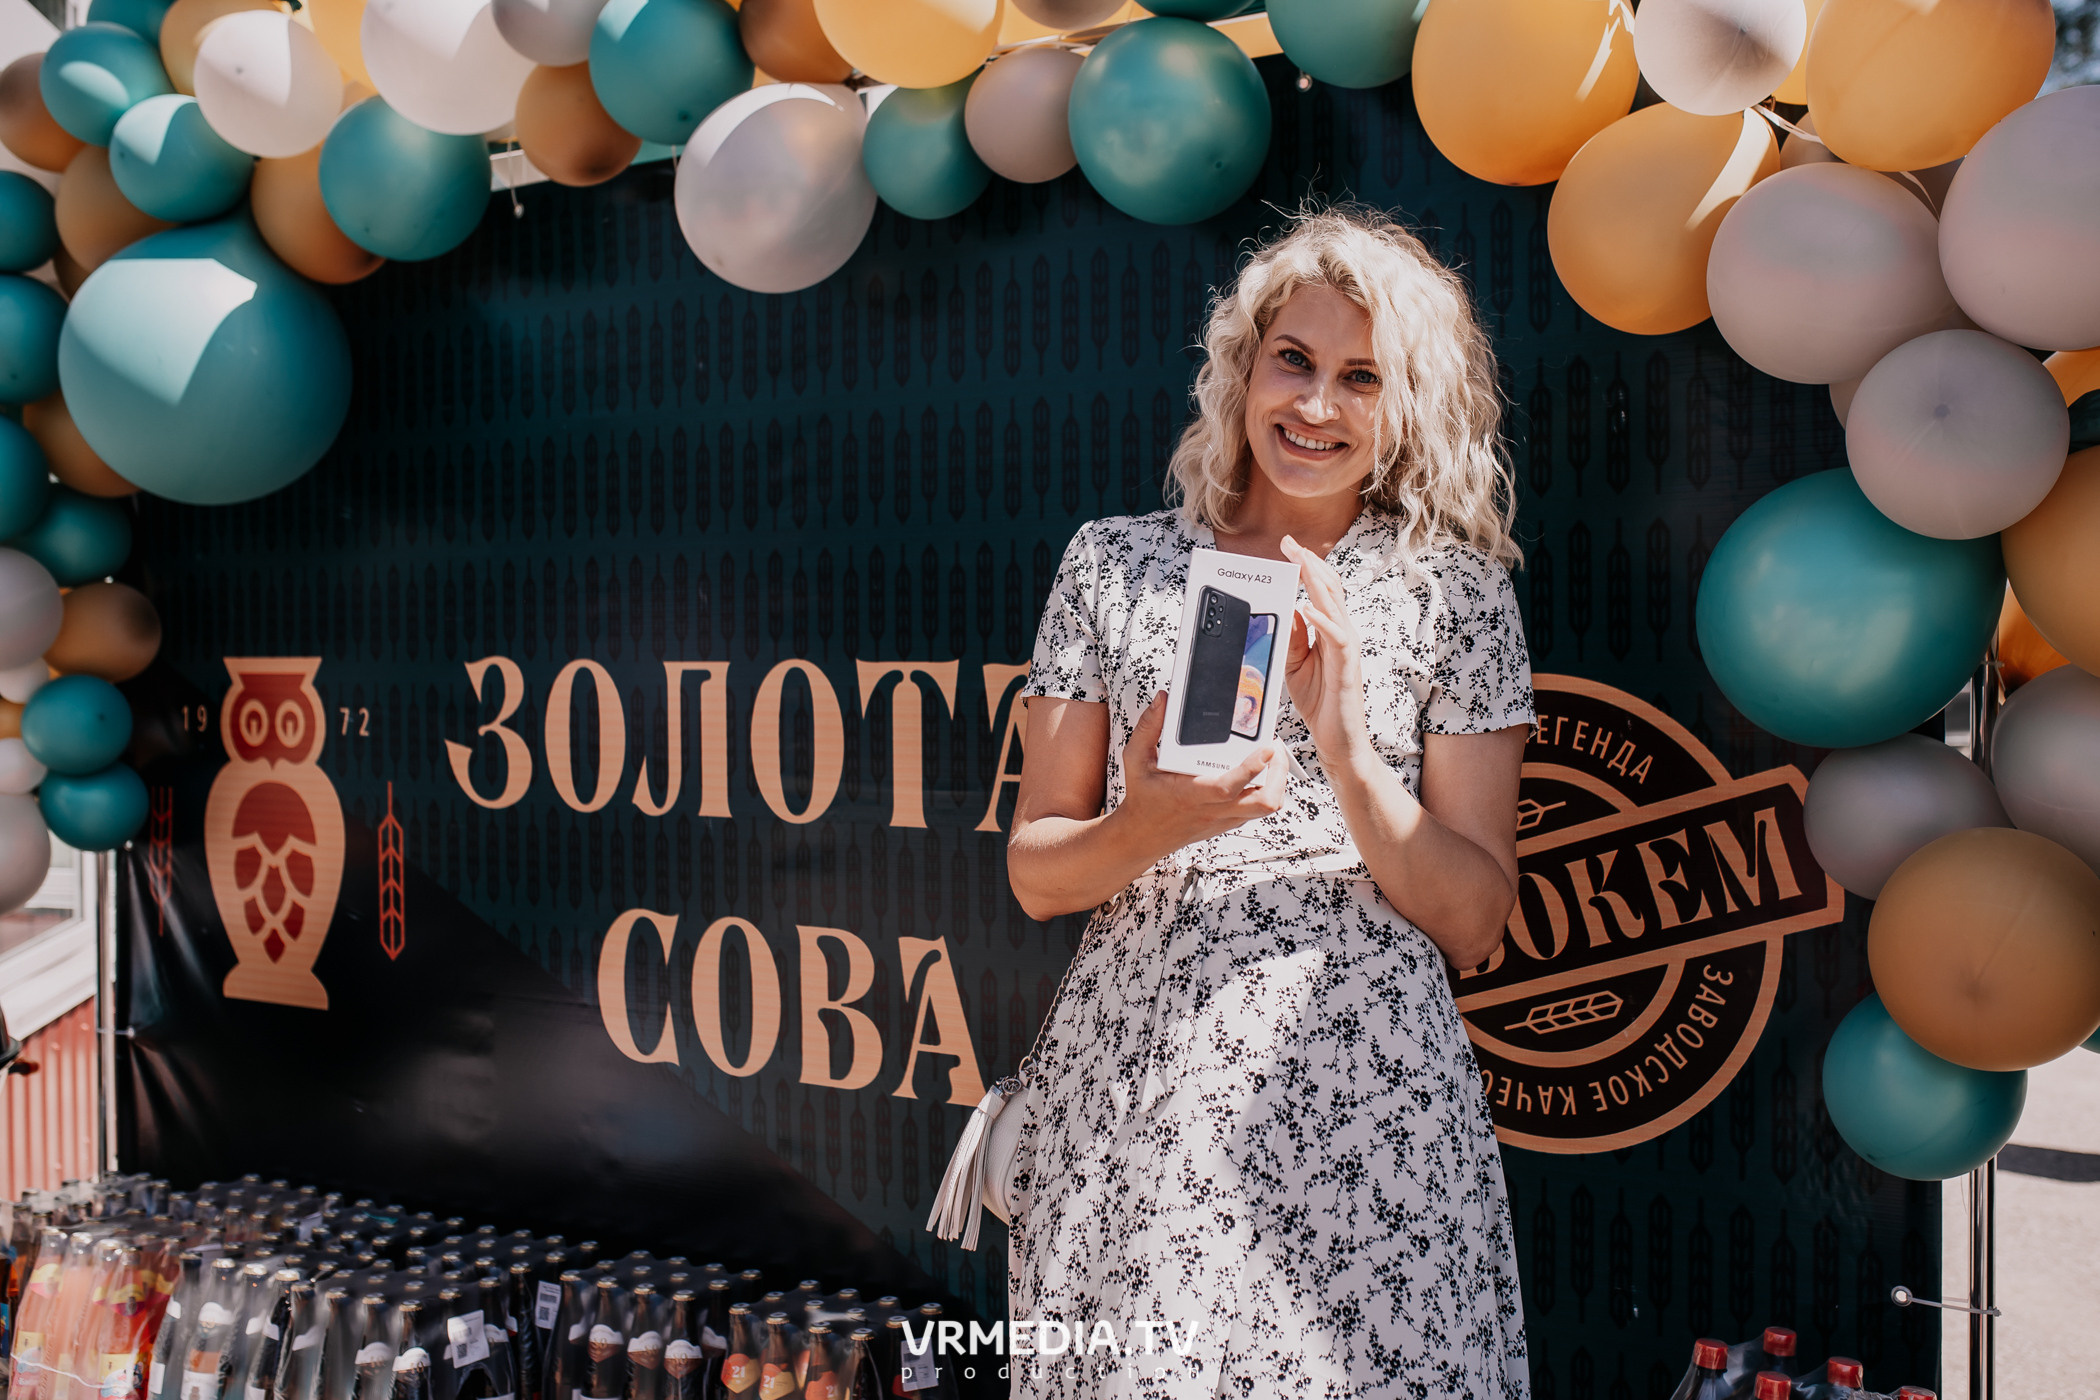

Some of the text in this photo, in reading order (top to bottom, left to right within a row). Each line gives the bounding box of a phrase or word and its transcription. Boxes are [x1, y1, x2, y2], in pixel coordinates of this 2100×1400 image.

[1217, 568, 1272, 584] Galaxy A23
[181, 705, 370, 736] 19 72
[444, 655, 1032, 832] ЗОЛОТА
[1525, 714, 1654, 785] ЕГЕНДА
[1196, 760, 1230, 770] SAMSUNG
[1459, 806, 1802, 979] ОКЕМ
[597, 908, 989, 1108] СОВА
[1588, 964, 1735, 1112] ЗАВОДСКОЕ
[731, 1365, 746, 1378] 21
